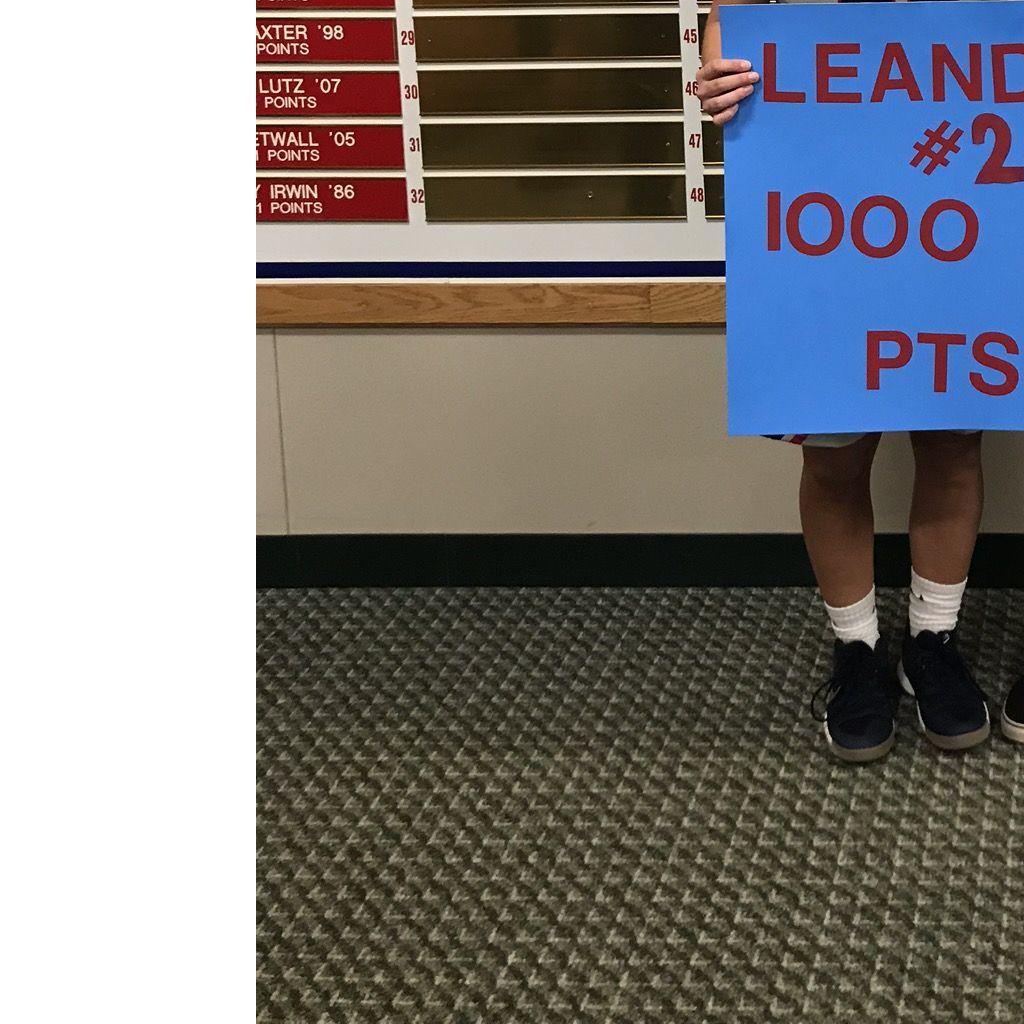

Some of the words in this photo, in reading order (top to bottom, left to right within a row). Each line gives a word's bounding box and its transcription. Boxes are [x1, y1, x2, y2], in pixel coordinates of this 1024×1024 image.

[317, 24, 344, 41] '98
[256, 42, 310, 56] POINTS
[258, 78, 306, 94] LUTZ
[315, 78, 342, 94] '07
[264, 95, 318, 109] POINTS
[329, 131, 356, 147] '05
[267, 149, 320, 162] POINTS
[270, 184, 318, 199] IRWIN
[329, 184, 355, 200] '86
[410, 188, 425, 204] 32
[689, 187, 705, 202] 48
[270, 201, 323, 214] POINTS
[866, 331, 1018, 396] PTS
